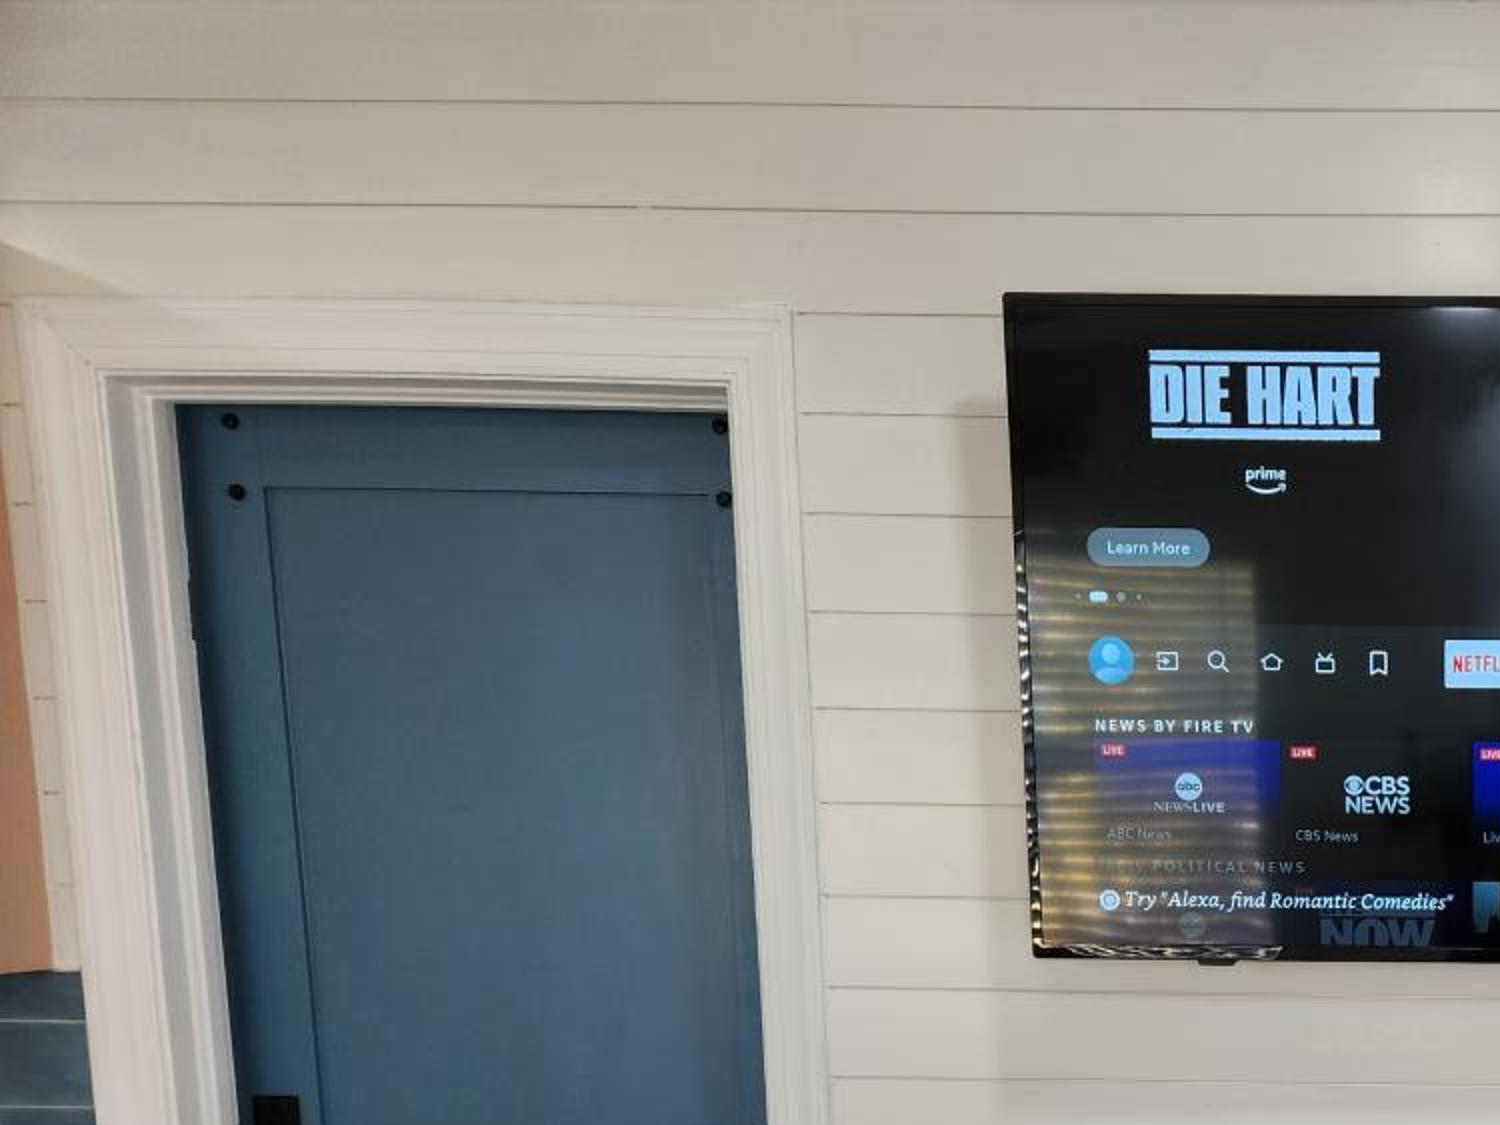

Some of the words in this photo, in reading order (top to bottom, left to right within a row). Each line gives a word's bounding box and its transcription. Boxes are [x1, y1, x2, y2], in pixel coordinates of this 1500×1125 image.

[1149, 365, 1233, 425] DIE
[1246, 365, 1380, 426] HART
[1245, 465, 1287, 482] prime
[1107, 540, 1149, 555] Learn
[1153, 540, 1191, 556] More
[1094, 719, 1147, 733] NEWS
[1153, 719, 1176, 733] BY
[1184, 719, 1224, 733] FIRE
[1230, 720, 1254, 734] TV
[1365, 775, 1410, 795] CBS
[1345, 796, 1411, 814] NEWS
[1296, 829, 1321, 841] CBS
[1324, 830, 1359, 843] News
[1153, 859, 1248, 874] POLITICAL
[1254, 860, 1306, 875] NEWS
[1126, 890, 1156, 911] Try
[1227, 889, 1266, 912] find
[1271, 890, 1357, 910] Romantic
